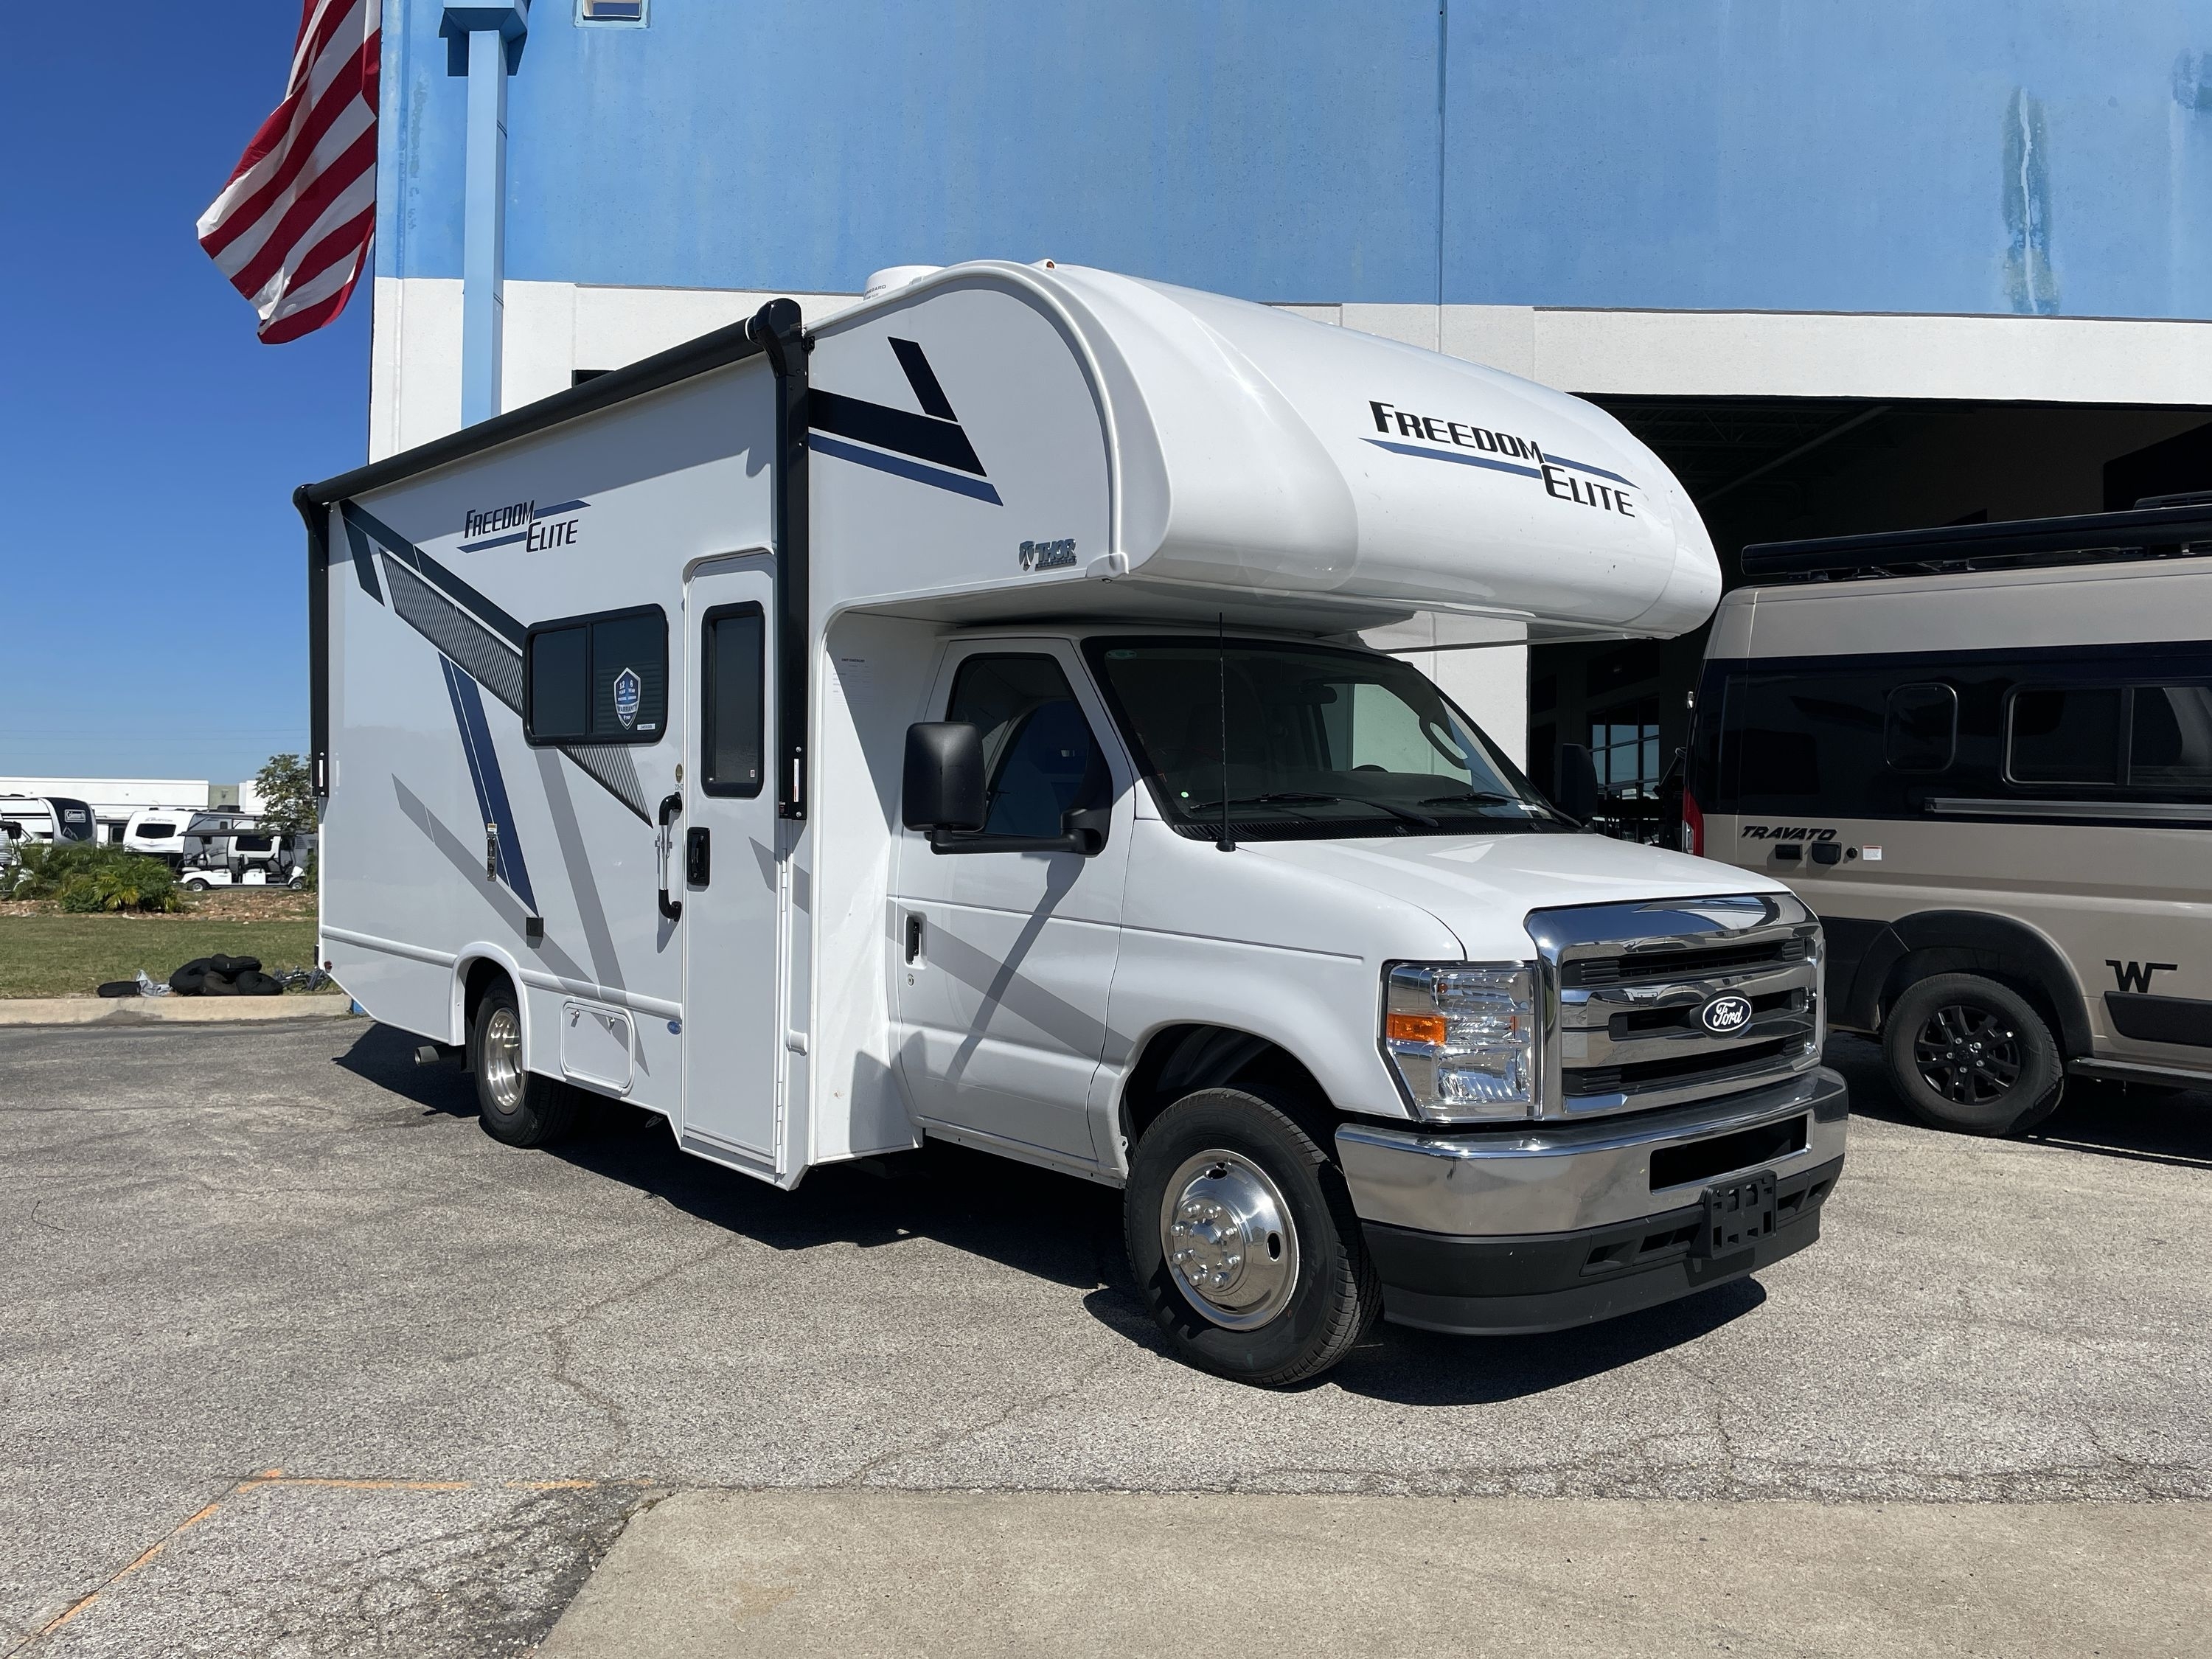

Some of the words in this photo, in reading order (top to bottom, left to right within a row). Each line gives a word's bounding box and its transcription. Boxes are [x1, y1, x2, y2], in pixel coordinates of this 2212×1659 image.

[1368, 400, 1545, 464] FREEDOM
[1541, 465, 1635, 518] ELITE
[465, 500, 535, 538] FREEDOM
[526, 519, 579, 553] ELITE
[1035, 539, 1076, 561] THOR
[619, 681, 625, 689] 12
[1741, 826, 1837, 841] TRAVATO
[1713, 1001, 1744, 1027] Ford
